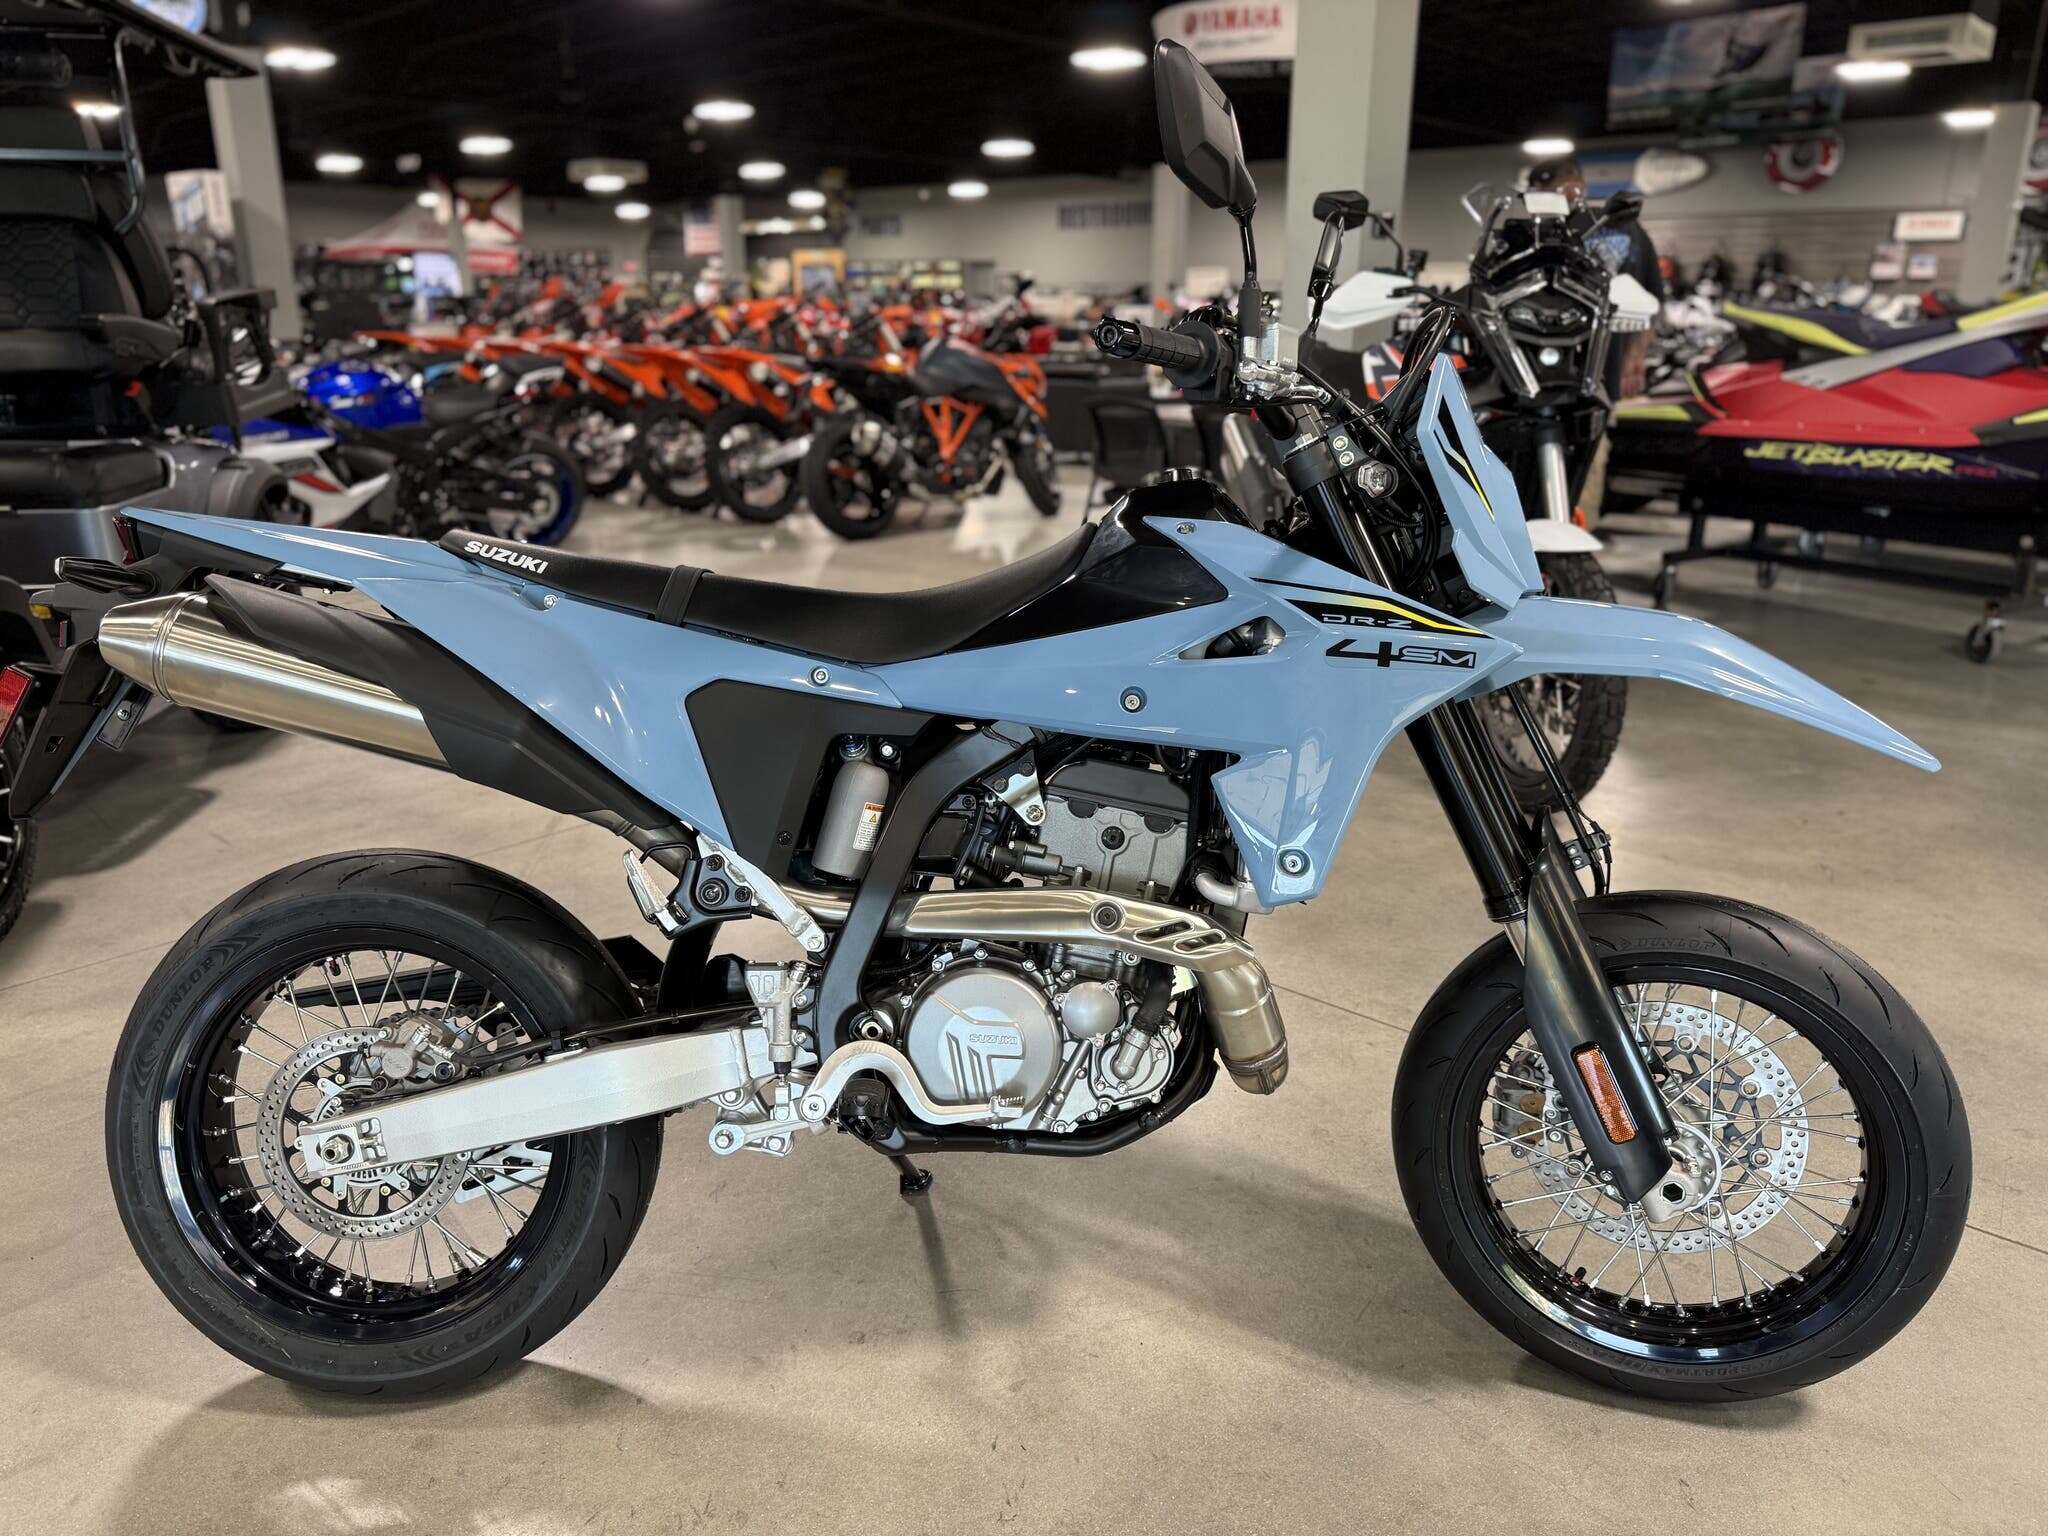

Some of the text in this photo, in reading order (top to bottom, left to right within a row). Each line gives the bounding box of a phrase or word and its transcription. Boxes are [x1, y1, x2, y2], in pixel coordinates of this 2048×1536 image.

[1199, 5, 1283, 32] YAMAHA
[464, 541, 549, 574] SUZUKI
[1321, 613, 1413, 629] DR-Z
[152, 956, 215, 1035] DUNLOP
[969, 1033, 1018, 1045] SUZUKI
